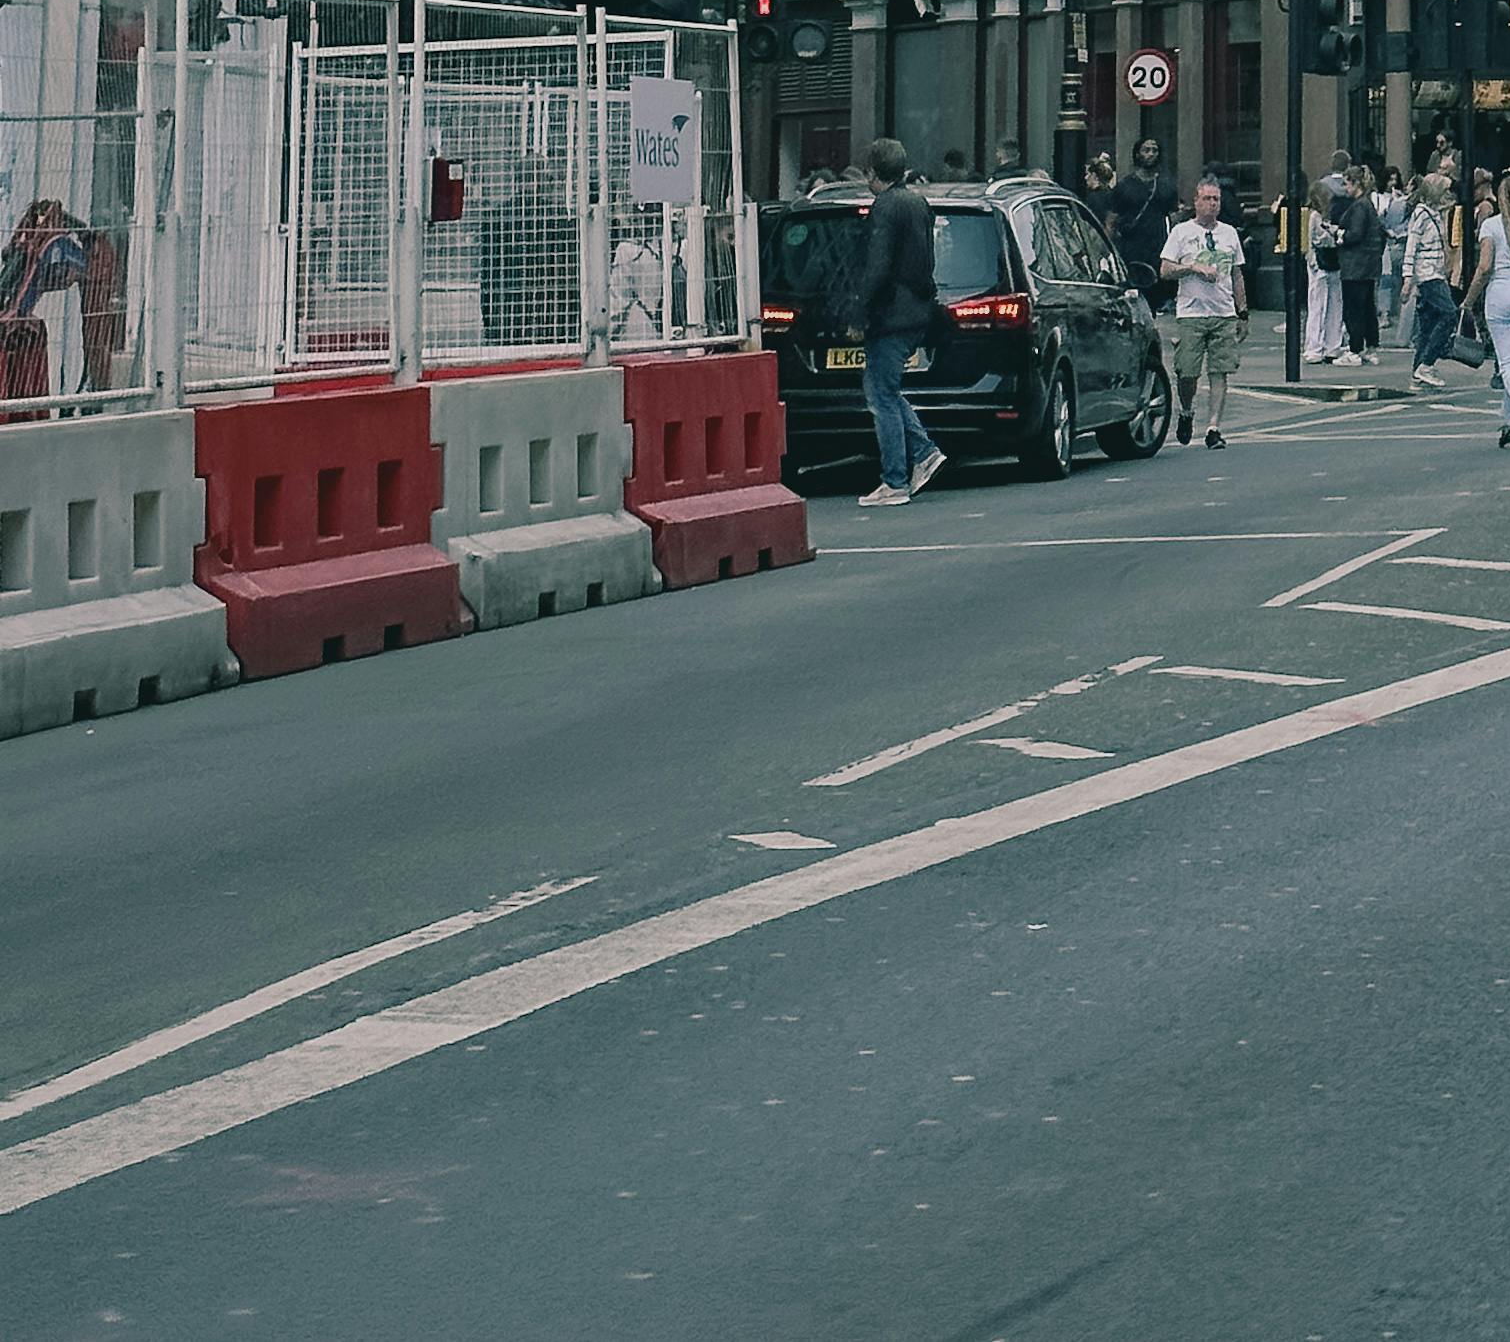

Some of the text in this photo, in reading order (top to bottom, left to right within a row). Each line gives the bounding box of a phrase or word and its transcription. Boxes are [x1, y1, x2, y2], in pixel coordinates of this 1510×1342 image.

[1131, 66, 1166, 89] 20
[635, 128, 680, 168] Wates
[833, 349, 867, 366] LK6
